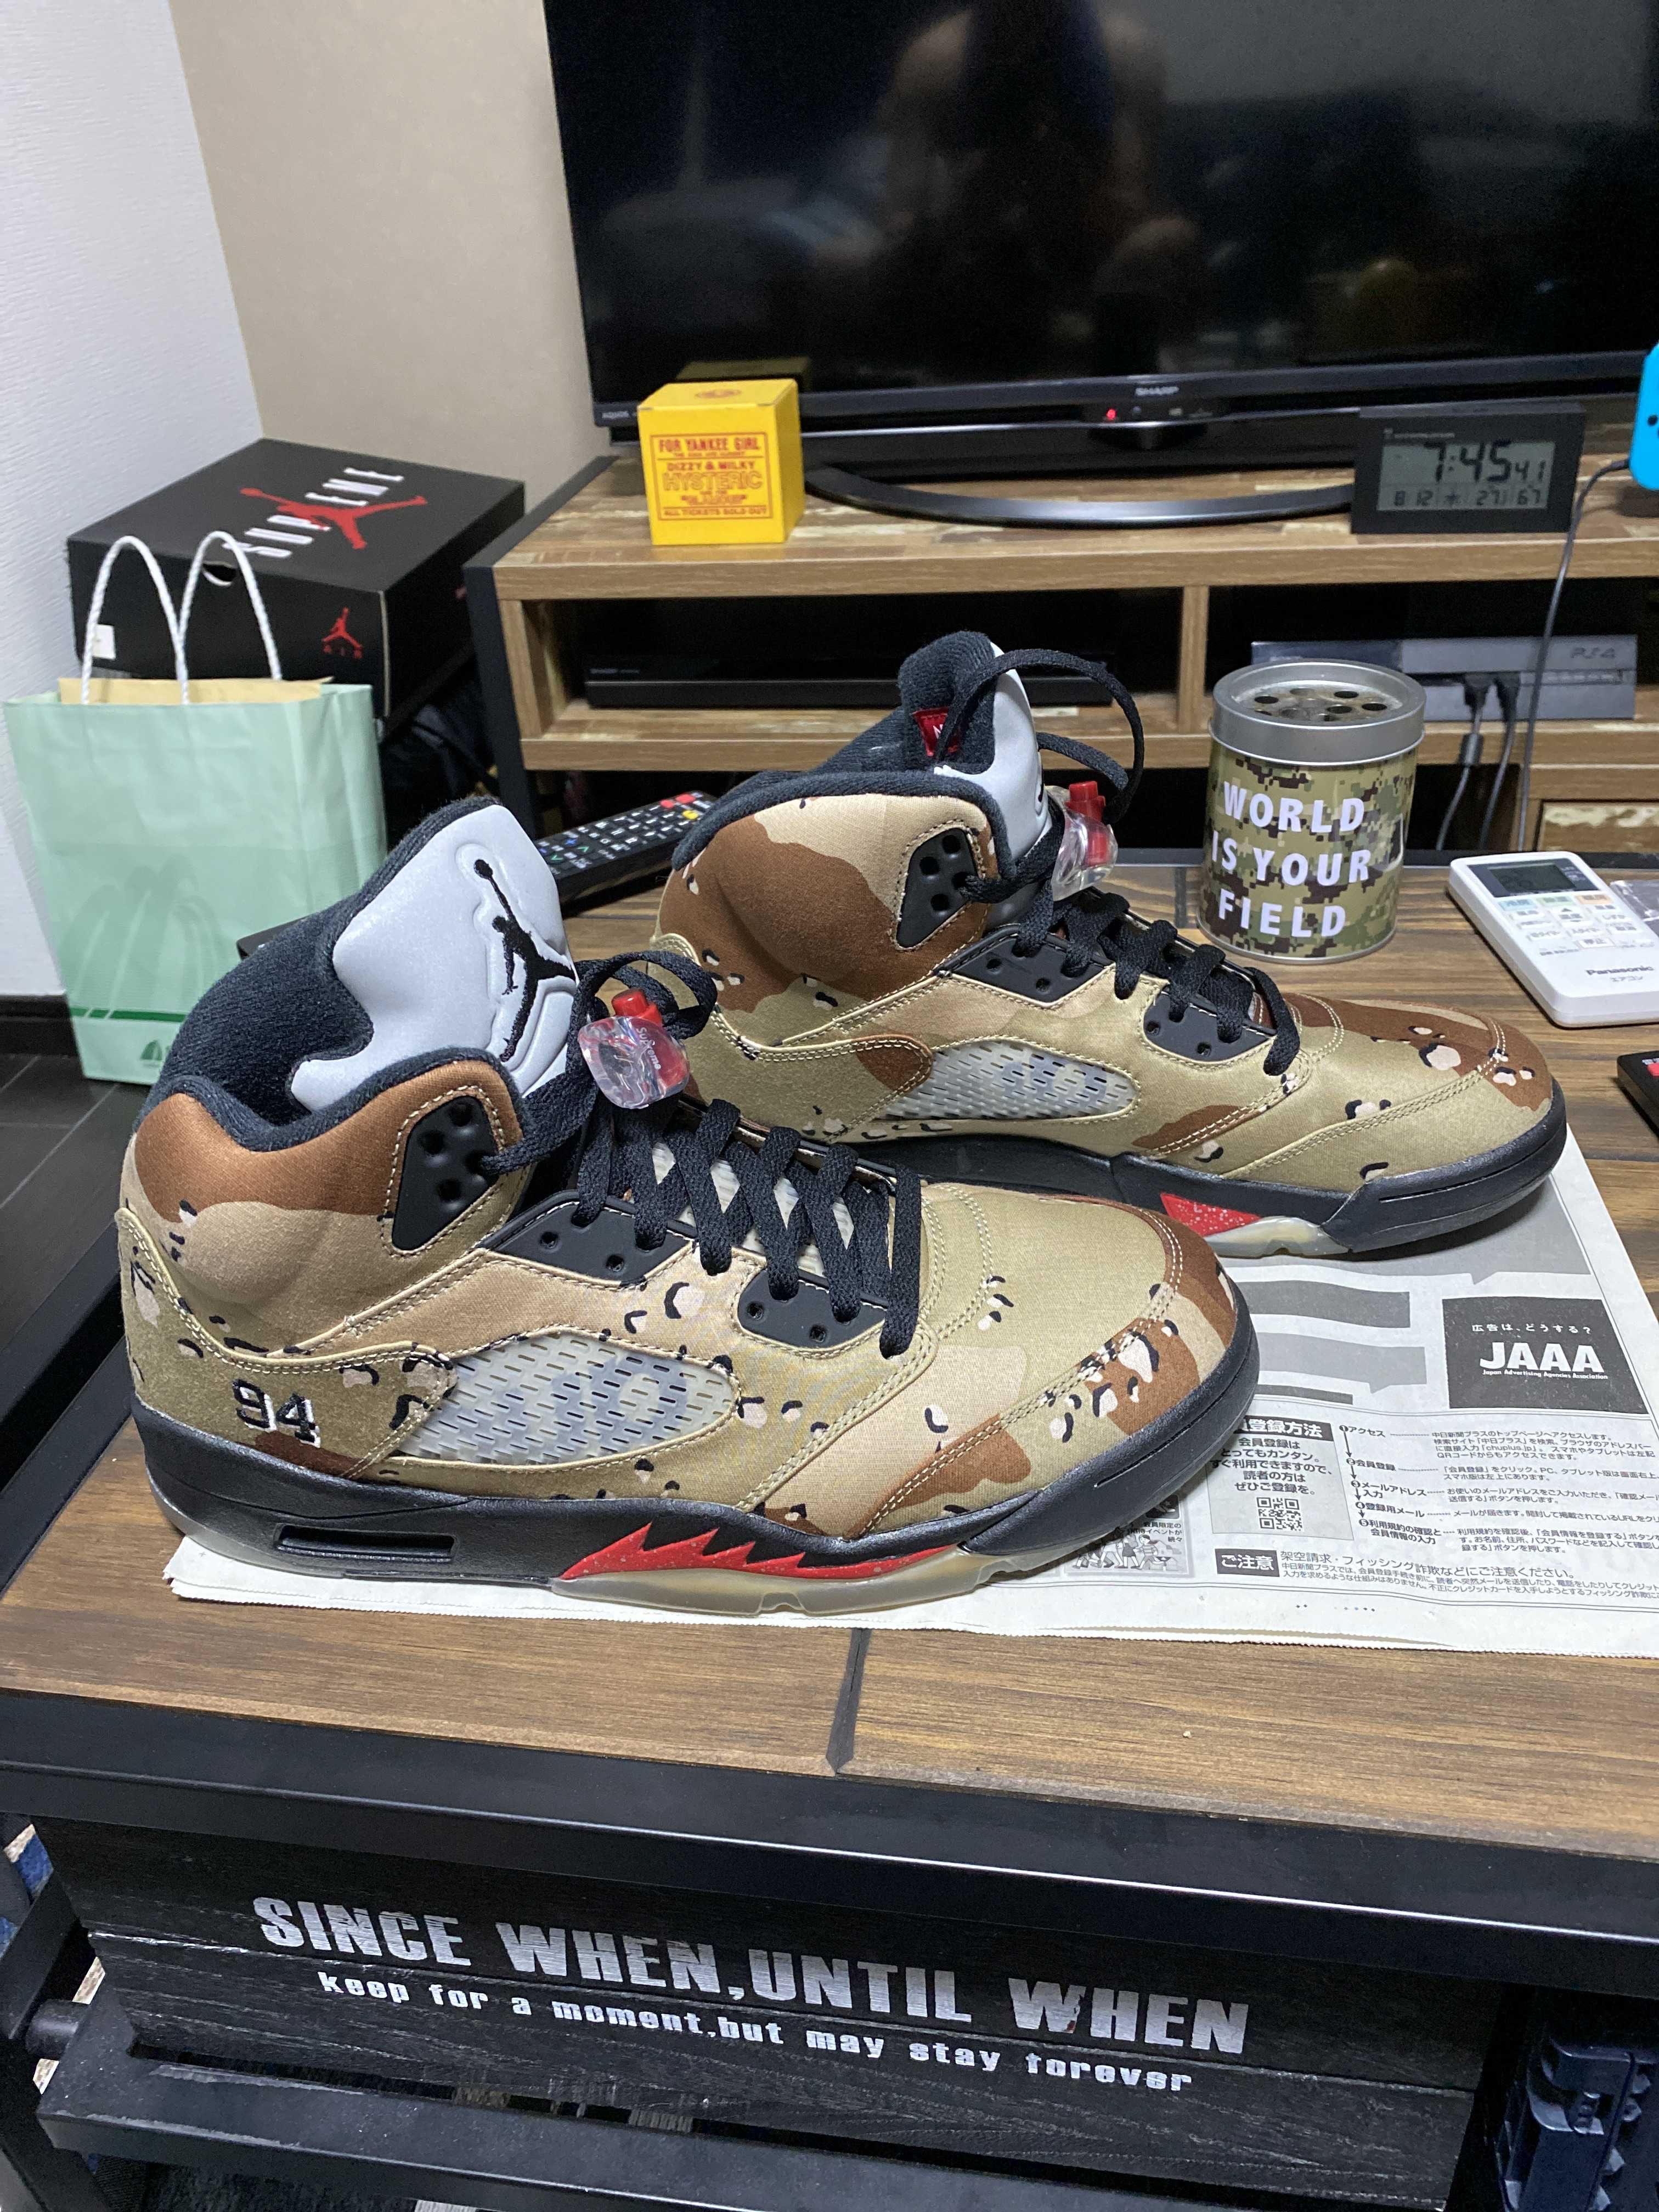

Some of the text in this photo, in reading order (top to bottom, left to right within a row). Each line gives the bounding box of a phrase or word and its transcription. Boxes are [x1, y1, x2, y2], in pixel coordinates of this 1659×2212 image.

[659, 439, 680, 453] FOR
[1424, 439, 1511, 482] 7:45
[662, 471, 763, 492] HYSTERIC
[1224, 781, 1364, 833] WORLD
[1212, 830, 1372, 886] IS YOUR
[1218, 888, 1346, 938] FIELD
[1585, 965, 1654, 975] Panasonic
[1480, 1342, 1605, 1373] JAAA
[1504, 1369, 1542, 1378] Advertising
[1238, 1437, 1300, 1449] 会員登録は
[1221, 1448, 1319, 1463] とってもカンタン。
[1437, 1452, 1577, 1460] QRコードからもアクセスできます。
[1210, 1459, 1332, 1475] すぐ利用できますので、
[1243, 1470, 1306, 1482] 読者の方は
[1234, 1482, 1314, 1495] ぜひご登録を。
[1363, 1488, 1383, 1498] 入力
[1449, 1496, 1559, 1504] 送信する」ボタンを押します。
[1370, 1528, 1436, 1544] 会員情報の入力
[1462, 1544, 1566, 1553] 録する」ボタンを押します。
[1221, 1554, 1274, 1570] ご注意
[1280, 1551, 1574, 1578] 架空請求・フィッシング詐欺などにご注意ください。
[253, 1897, 471, 1967] SINCE
[1008, 1977, 1249, 2054] WHEN
[318, 1972, 409, 2003] keep
[428, 1984, 488, 2009] for
[511, 1997, 532, 2015] a
[806, 2030, 884, 2058] may
[909, 2042, 1001, 2072] stay
